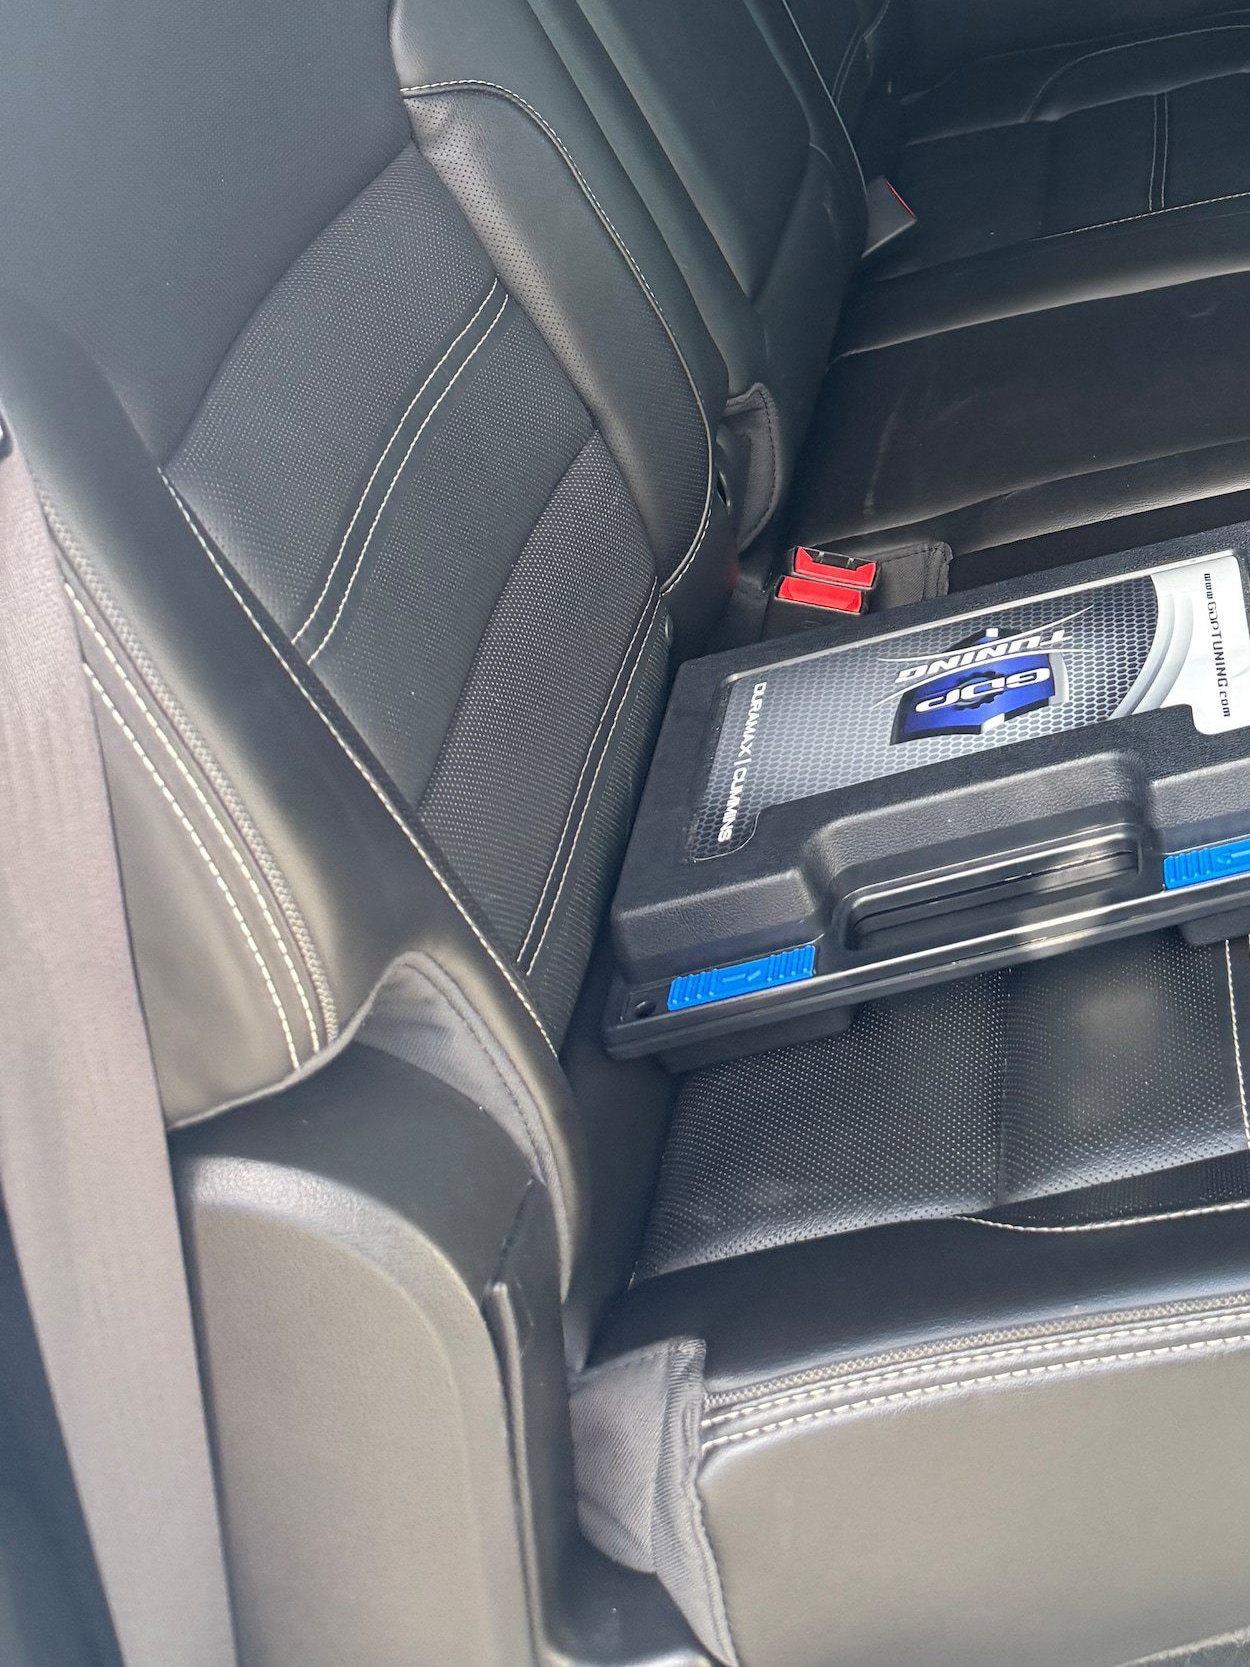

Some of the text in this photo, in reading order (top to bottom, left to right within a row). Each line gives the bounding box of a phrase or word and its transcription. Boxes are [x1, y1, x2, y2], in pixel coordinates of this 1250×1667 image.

[894, 629, 1073, 684] TUNING
[738, 681, 767, 757] DURAMAX
[717, 767, 747, 842] CUMMINS
